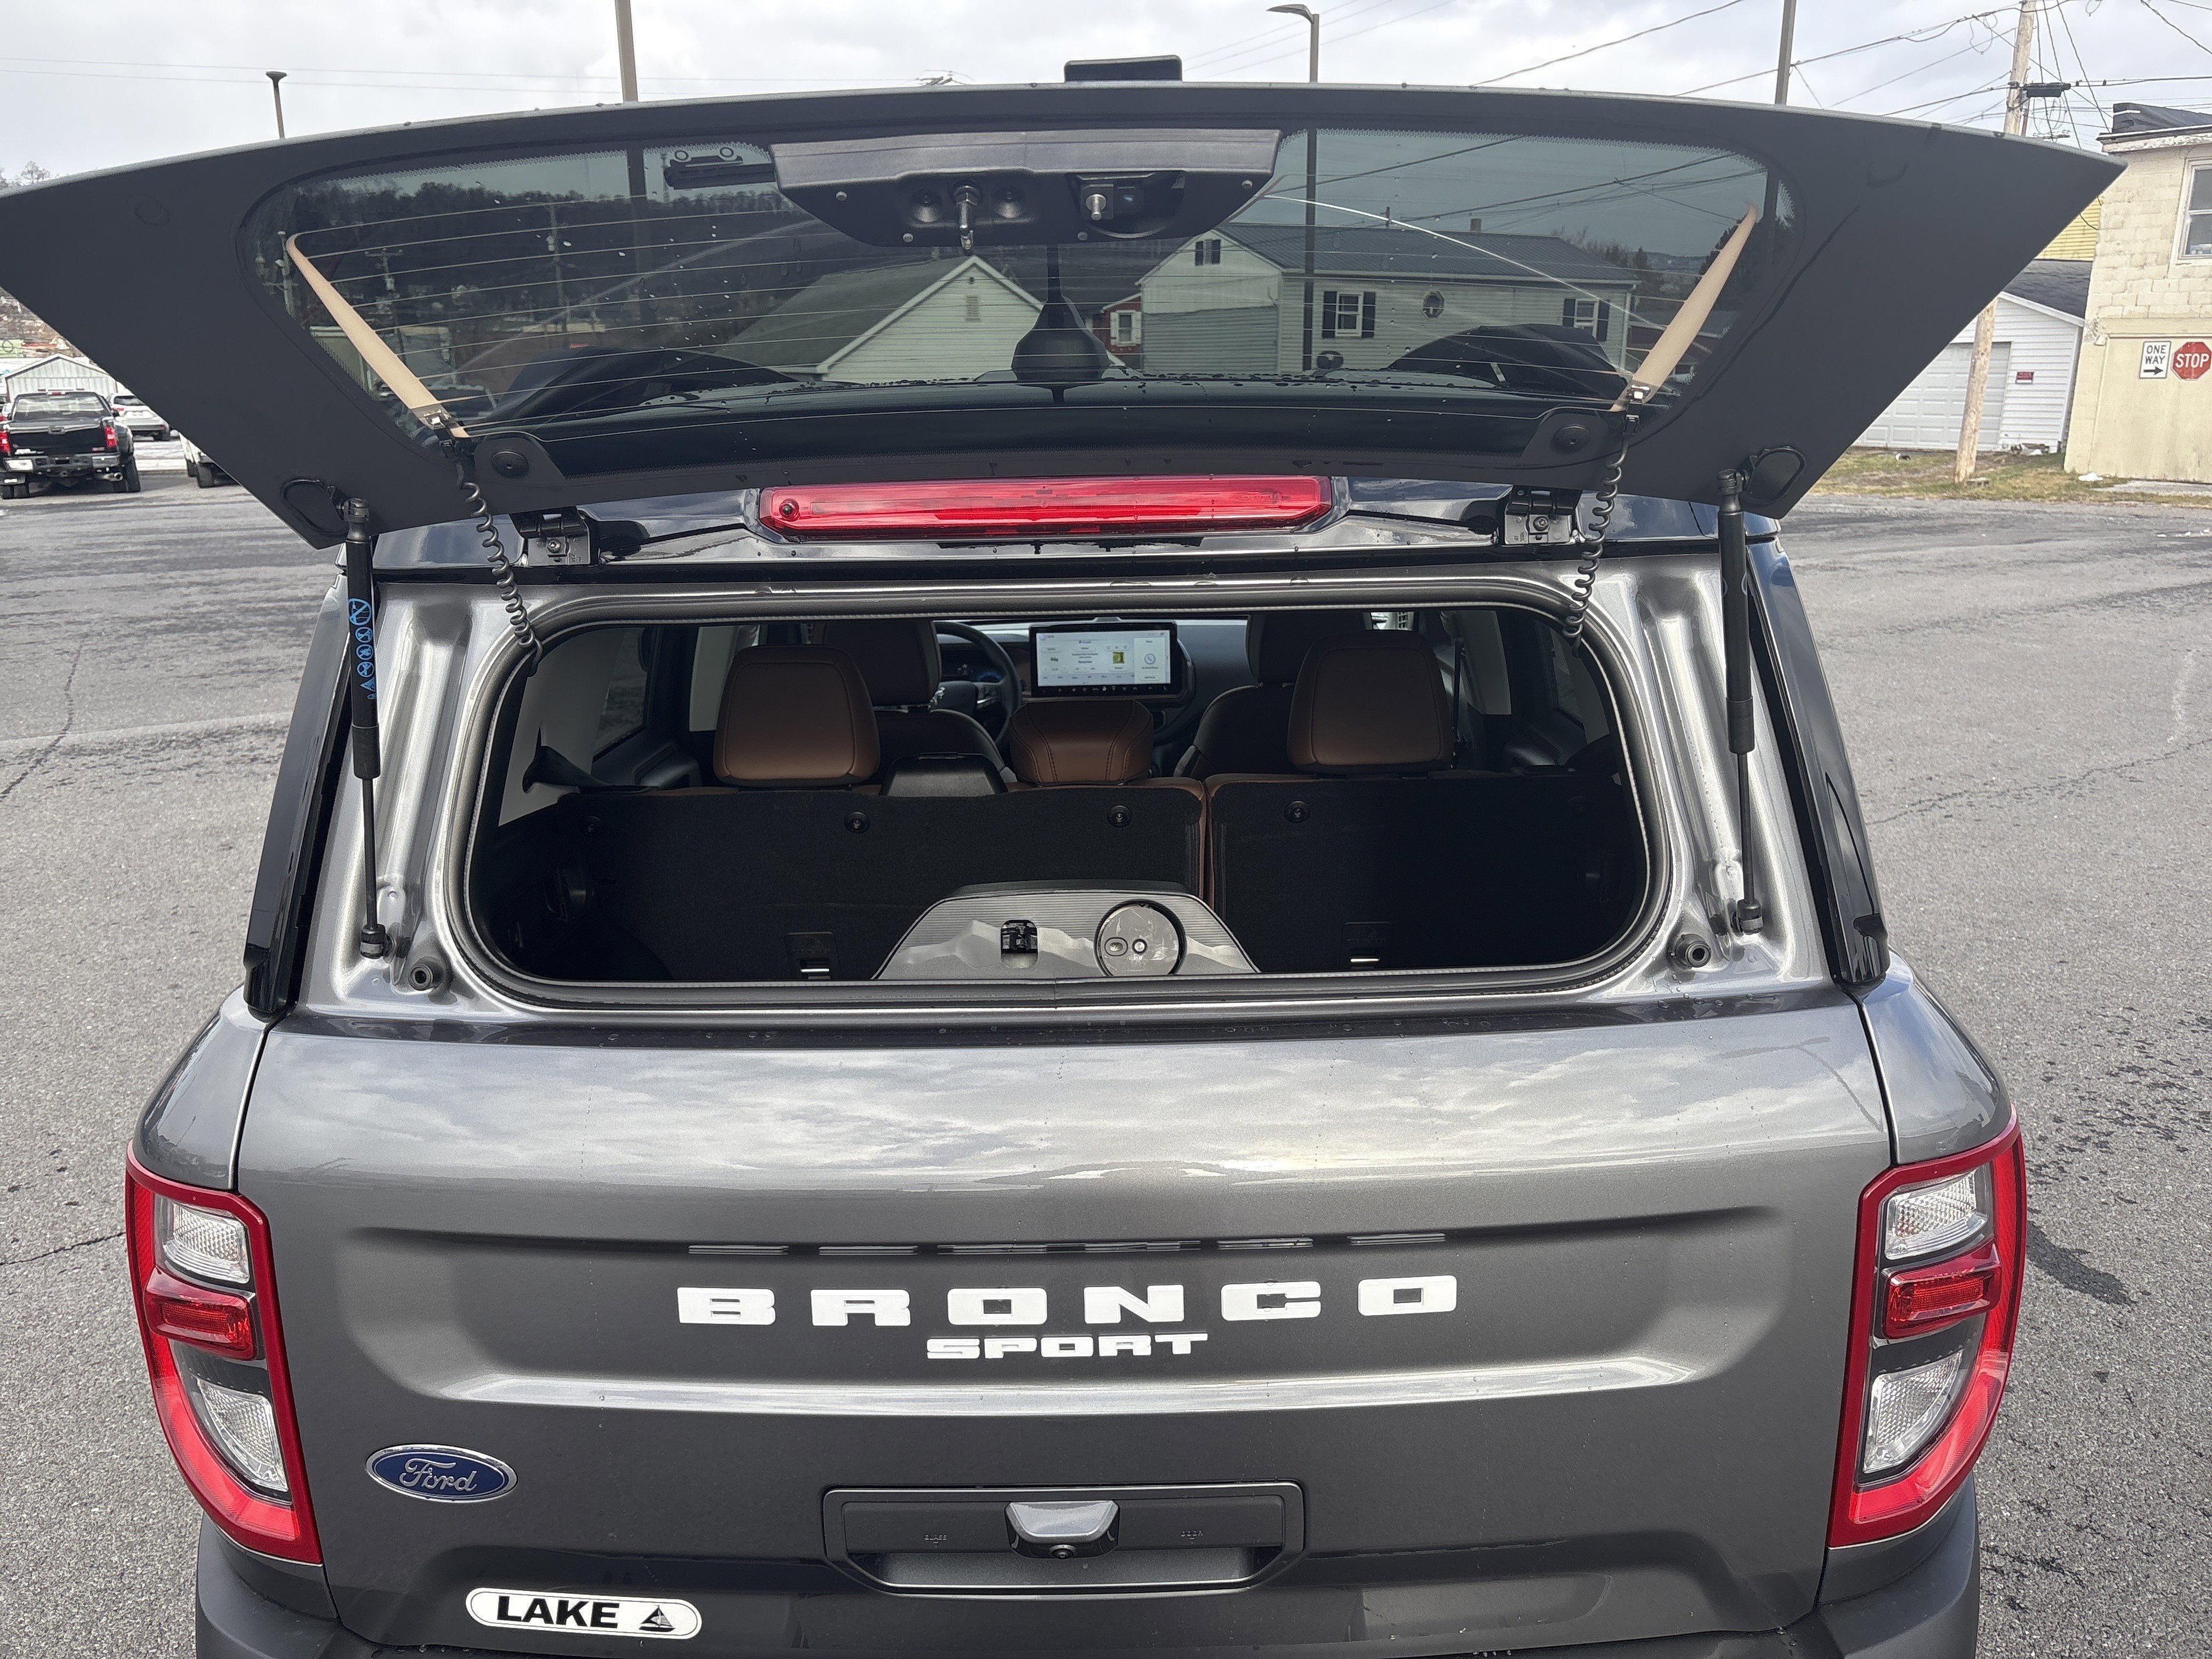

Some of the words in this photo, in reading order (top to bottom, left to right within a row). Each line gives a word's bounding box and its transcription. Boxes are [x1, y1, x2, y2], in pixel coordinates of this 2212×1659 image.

[2145, 356, 2165, 365] WAY
[2146, 345, 2166, 354] ONE
[2175, 353, 2209, 368] STOP
[676, 1274, 1458, 1327] BRONCO
[927, 1333, 1208, 1359] SPORT
[399, 1458, 478, 1492] Ford
[496, 1595, 619, 1629] LAKE
